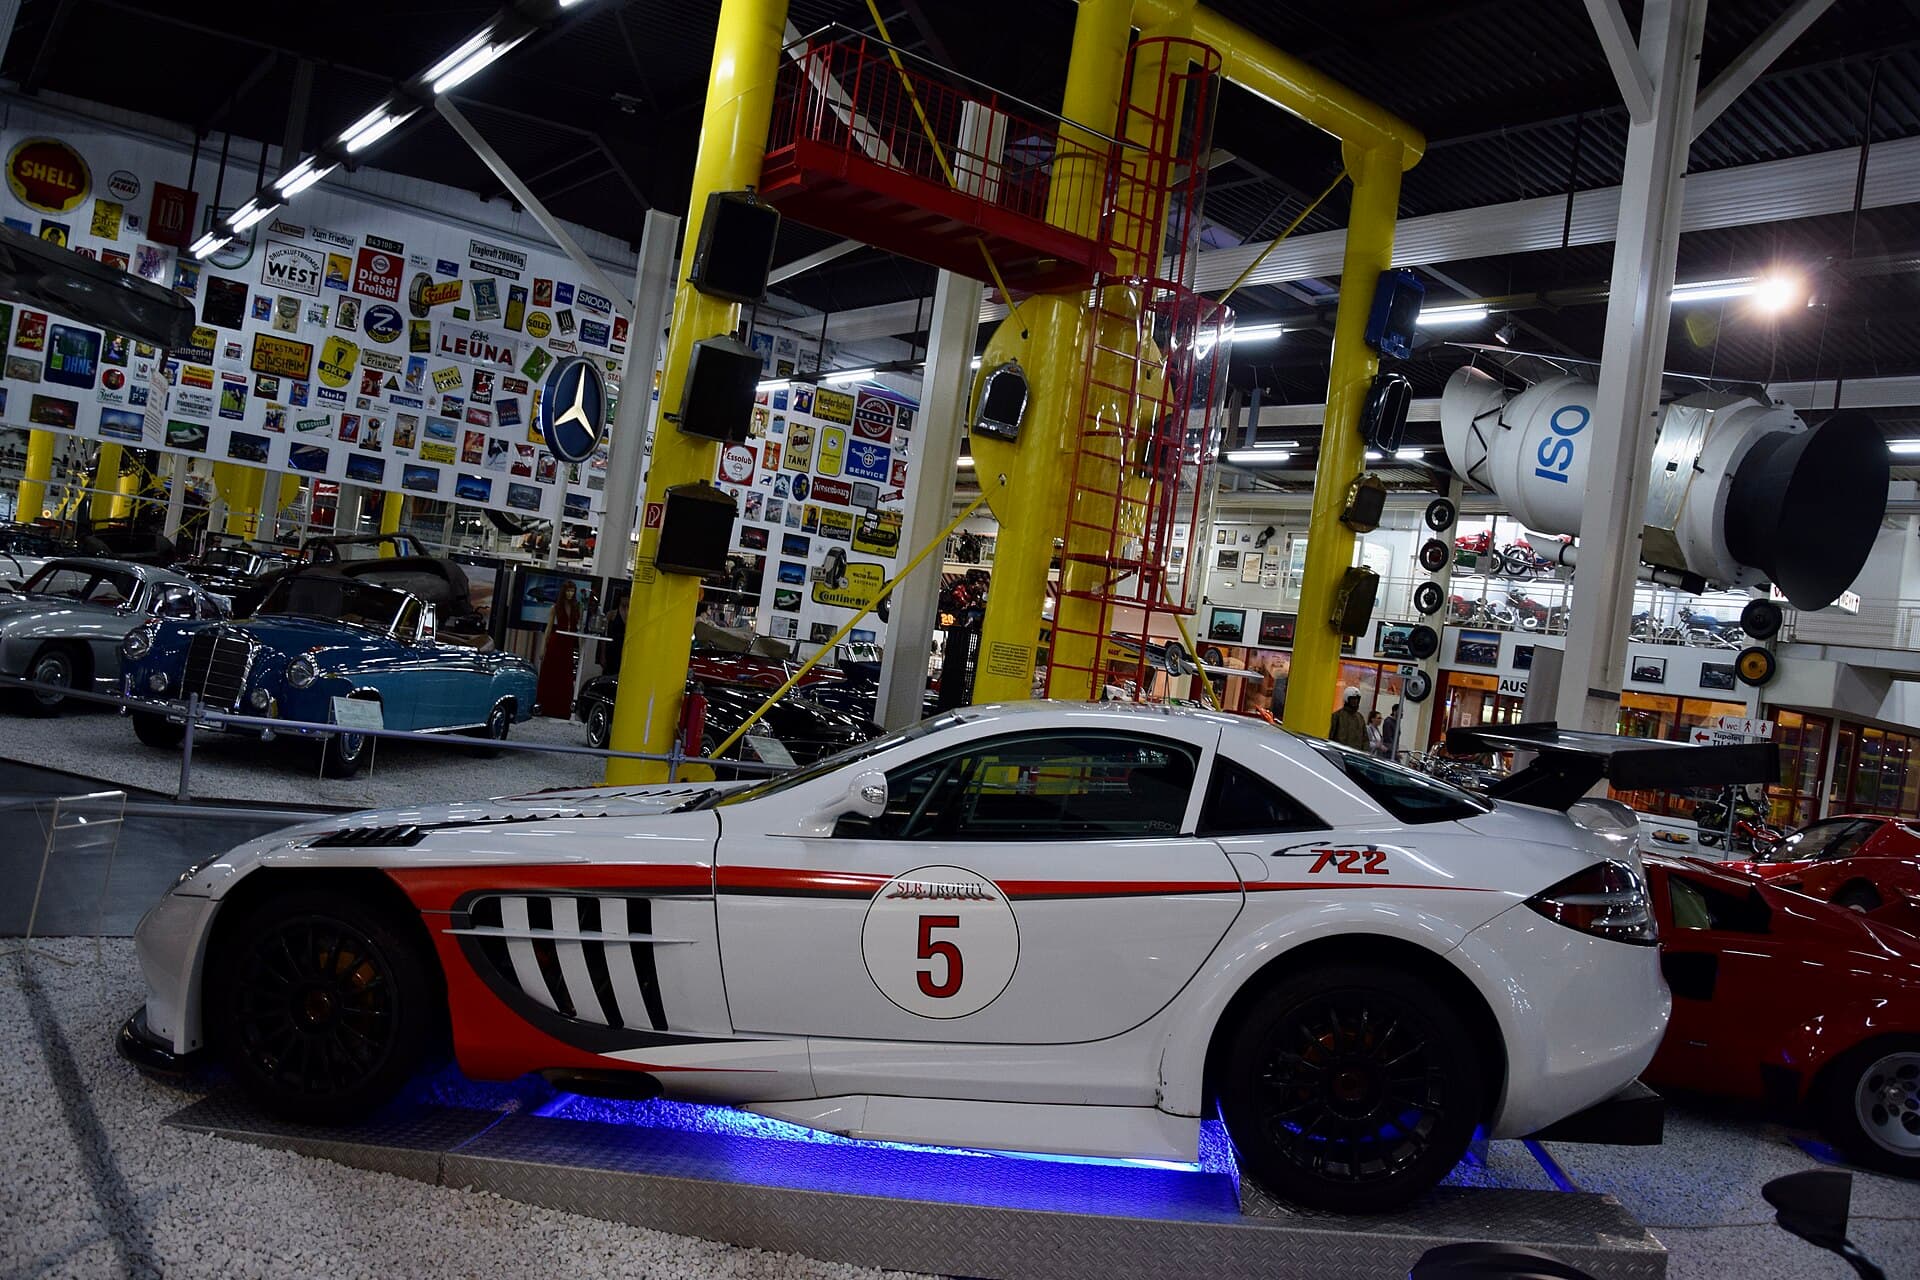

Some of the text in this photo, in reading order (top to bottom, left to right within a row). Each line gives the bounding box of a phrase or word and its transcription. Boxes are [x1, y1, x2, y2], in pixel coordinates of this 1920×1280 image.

[21, 160, 76, 190] SHELL
[312, 228, 327, 239] Zum
[329, 232, 354, 246] Friedhof
[269, 249, 320, 271] DRUCKLUFTBREMSE
[472, 243, 497, 259] Tragkraft
[268, 261, 319, 285] WEST
[360, 268, 398, 287] Diesel
[358, 280, 396, 298] Treiböl
[424, 284, 459, 304] Fulda
[528, 319, 550, 330] SOLEX
[441, 335, 514, 366] LEUNA
[324, 364, 347, 377] DKW
[366, 357, 400, 370] Friseur
[321, 389, 345, 400] Miele
[1535, 405, 1590, 484] ISO
[726, 452, 752, 465] Essolub
[788, 455, 807, 467] TANK
[849, 466, 885, 480] SERVICE
[1308, 849, 1390, 874] 722
[916, 914, 964, 999] 5
